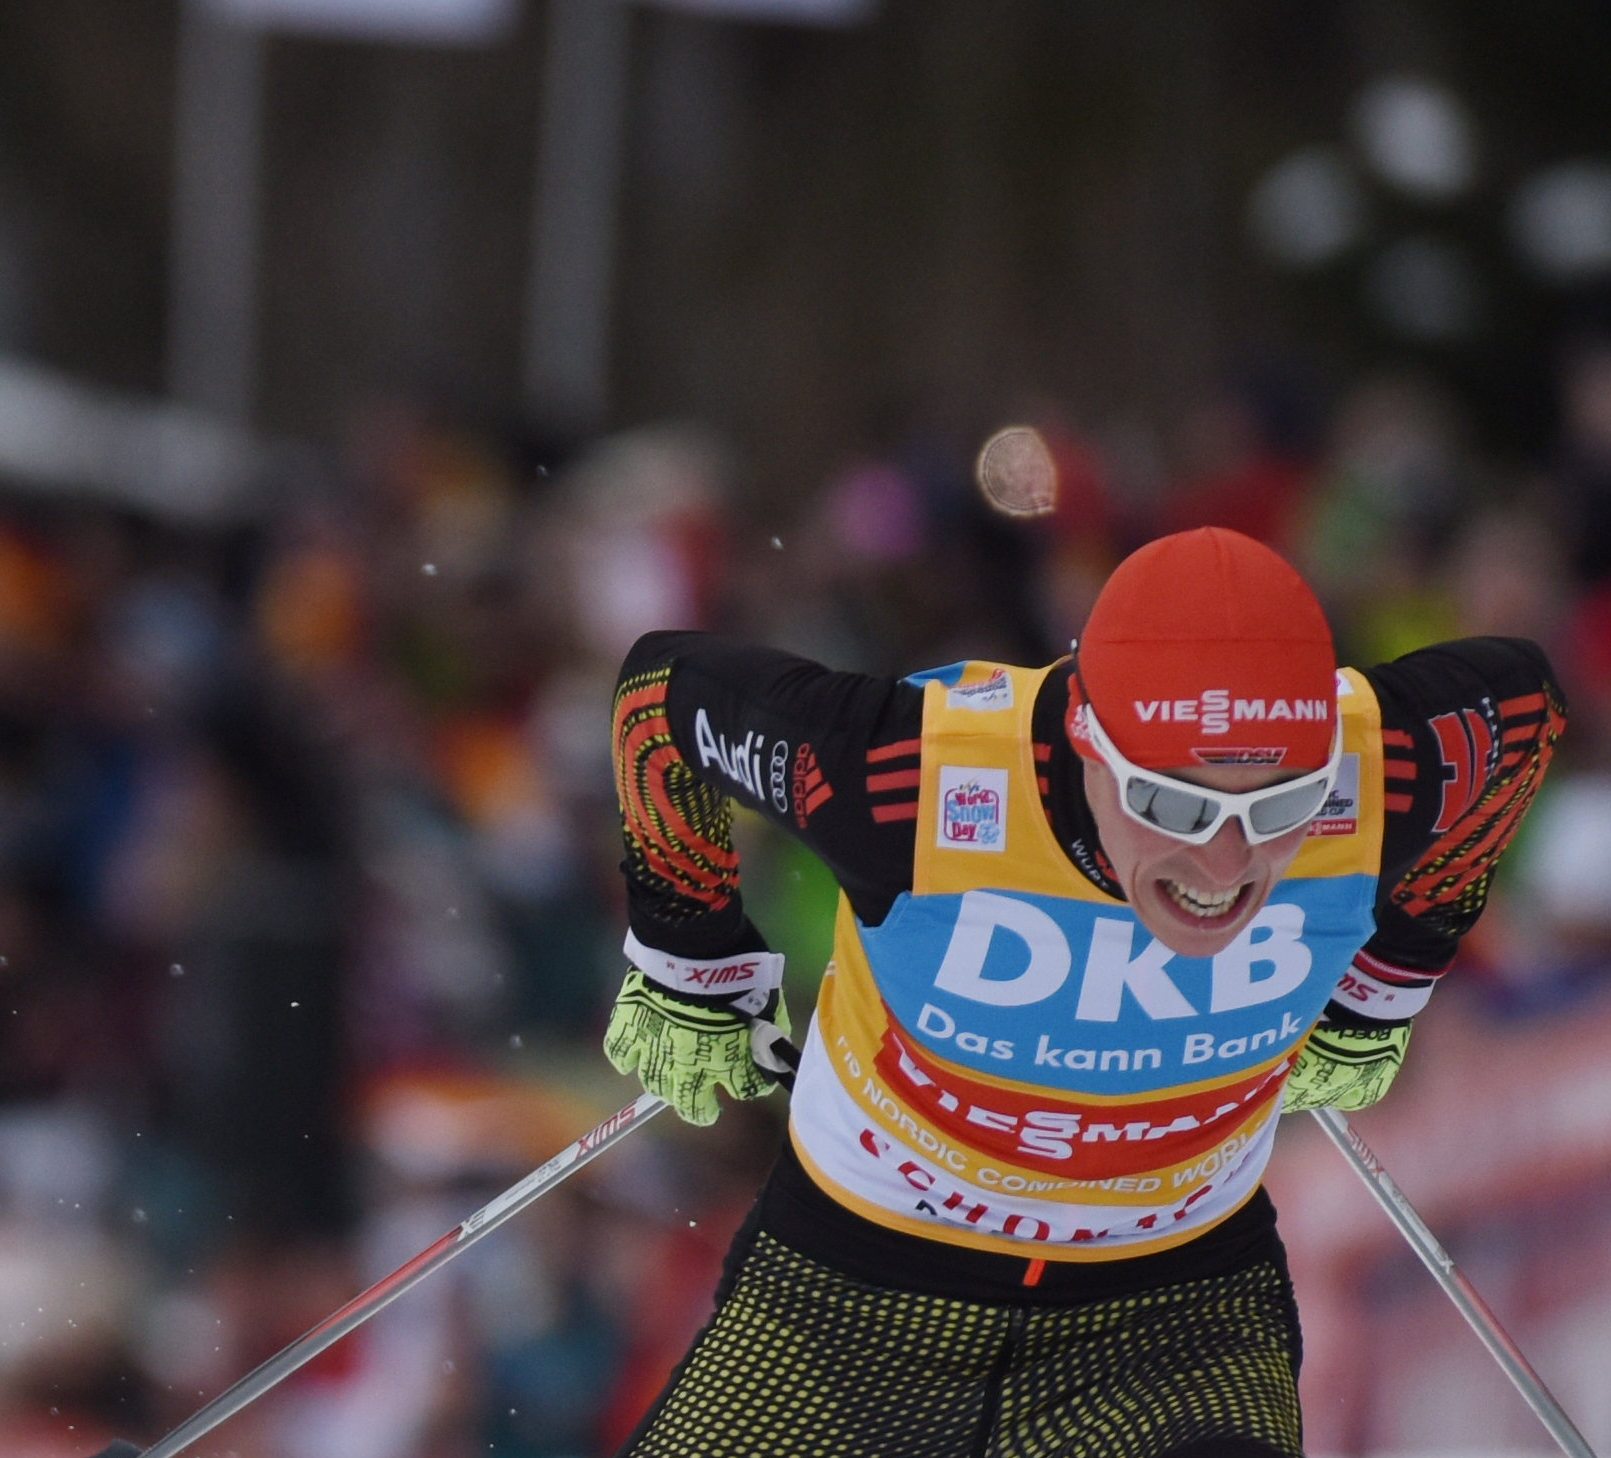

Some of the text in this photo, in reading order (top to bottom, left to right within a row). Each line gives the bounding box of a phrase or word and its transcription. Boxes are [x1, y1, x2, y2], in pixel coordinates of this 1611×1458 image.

[1134, 689, 1328, 734] VIESSMANN
[695, 708, 766, 801] Audi
[946, 799, 995, 822] Snow
[952, 822, 977, 839] Day
[933, 890, 1313, 1023] DKB
[916, 1003, 1303, 1071] Das kann Bank
[862, 1078, 969, 1171] NORDIC
